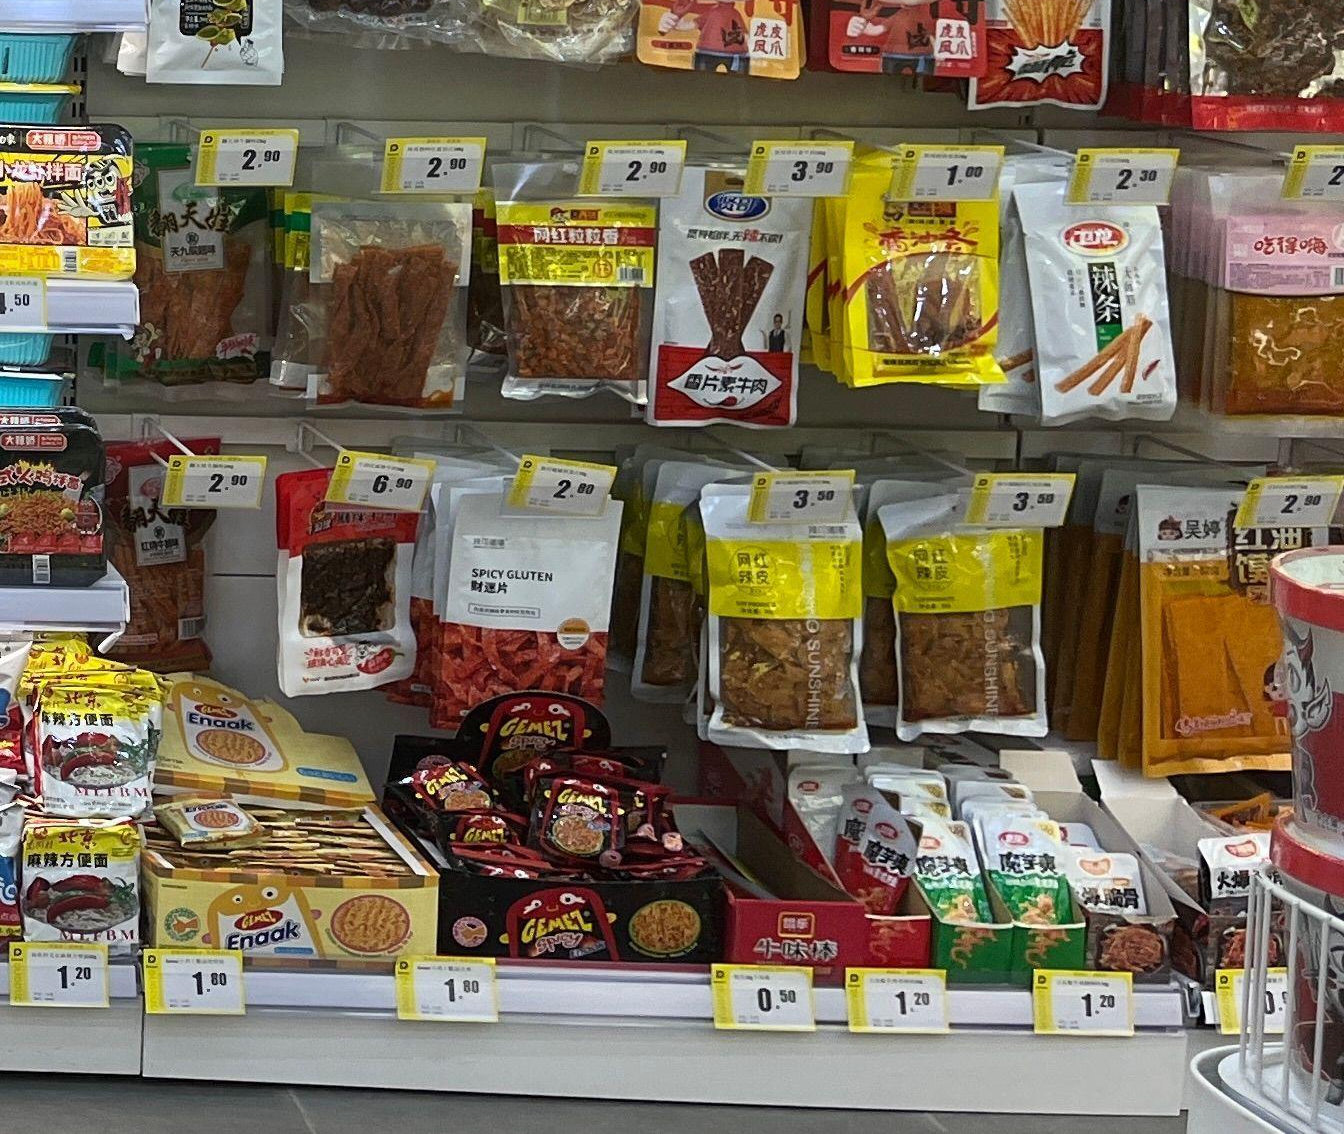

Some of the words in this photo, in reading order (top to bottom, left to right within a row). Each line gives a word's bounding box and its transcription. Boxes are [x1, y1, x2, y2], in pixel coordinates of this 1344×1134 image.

[428, 157, 466, 179] 2.90
[946, 164, 983, 186] 1.00
[534, 227, 619, 244] 网红粒粒香
[1254, 236, 1328, 255] 吃得嗨
[1091, 263, 1121, 323] 辣条
[373, 474, 412, 495] 6.90
[1013, 492, 1055, 511] 3.50
[1185, 519, 1221, 539] 吴婷
[472, 568, 504, 580] SPICY
[507, 571, 553, 583] GLUTEN
[41, 712, 114, 728] 麻辣方便面
[187, 713, 253, 730] Enaak
[502, 719, 570, 742] GEMEZ
[27, 852, 109, 869] 麻辣方便面
[999, 852, 1058, 876] 魔芋爽
[226, 922, 300, 951] Enaak
[521, 910, 592, 942] GEMEZ
[753, 938, 838, 962] 牛味棒
[57, 966, 91, 989] 1.20
[758, 989, 796, 1013] 0.50
[1082, 993, 1115, 1017] 1.20
